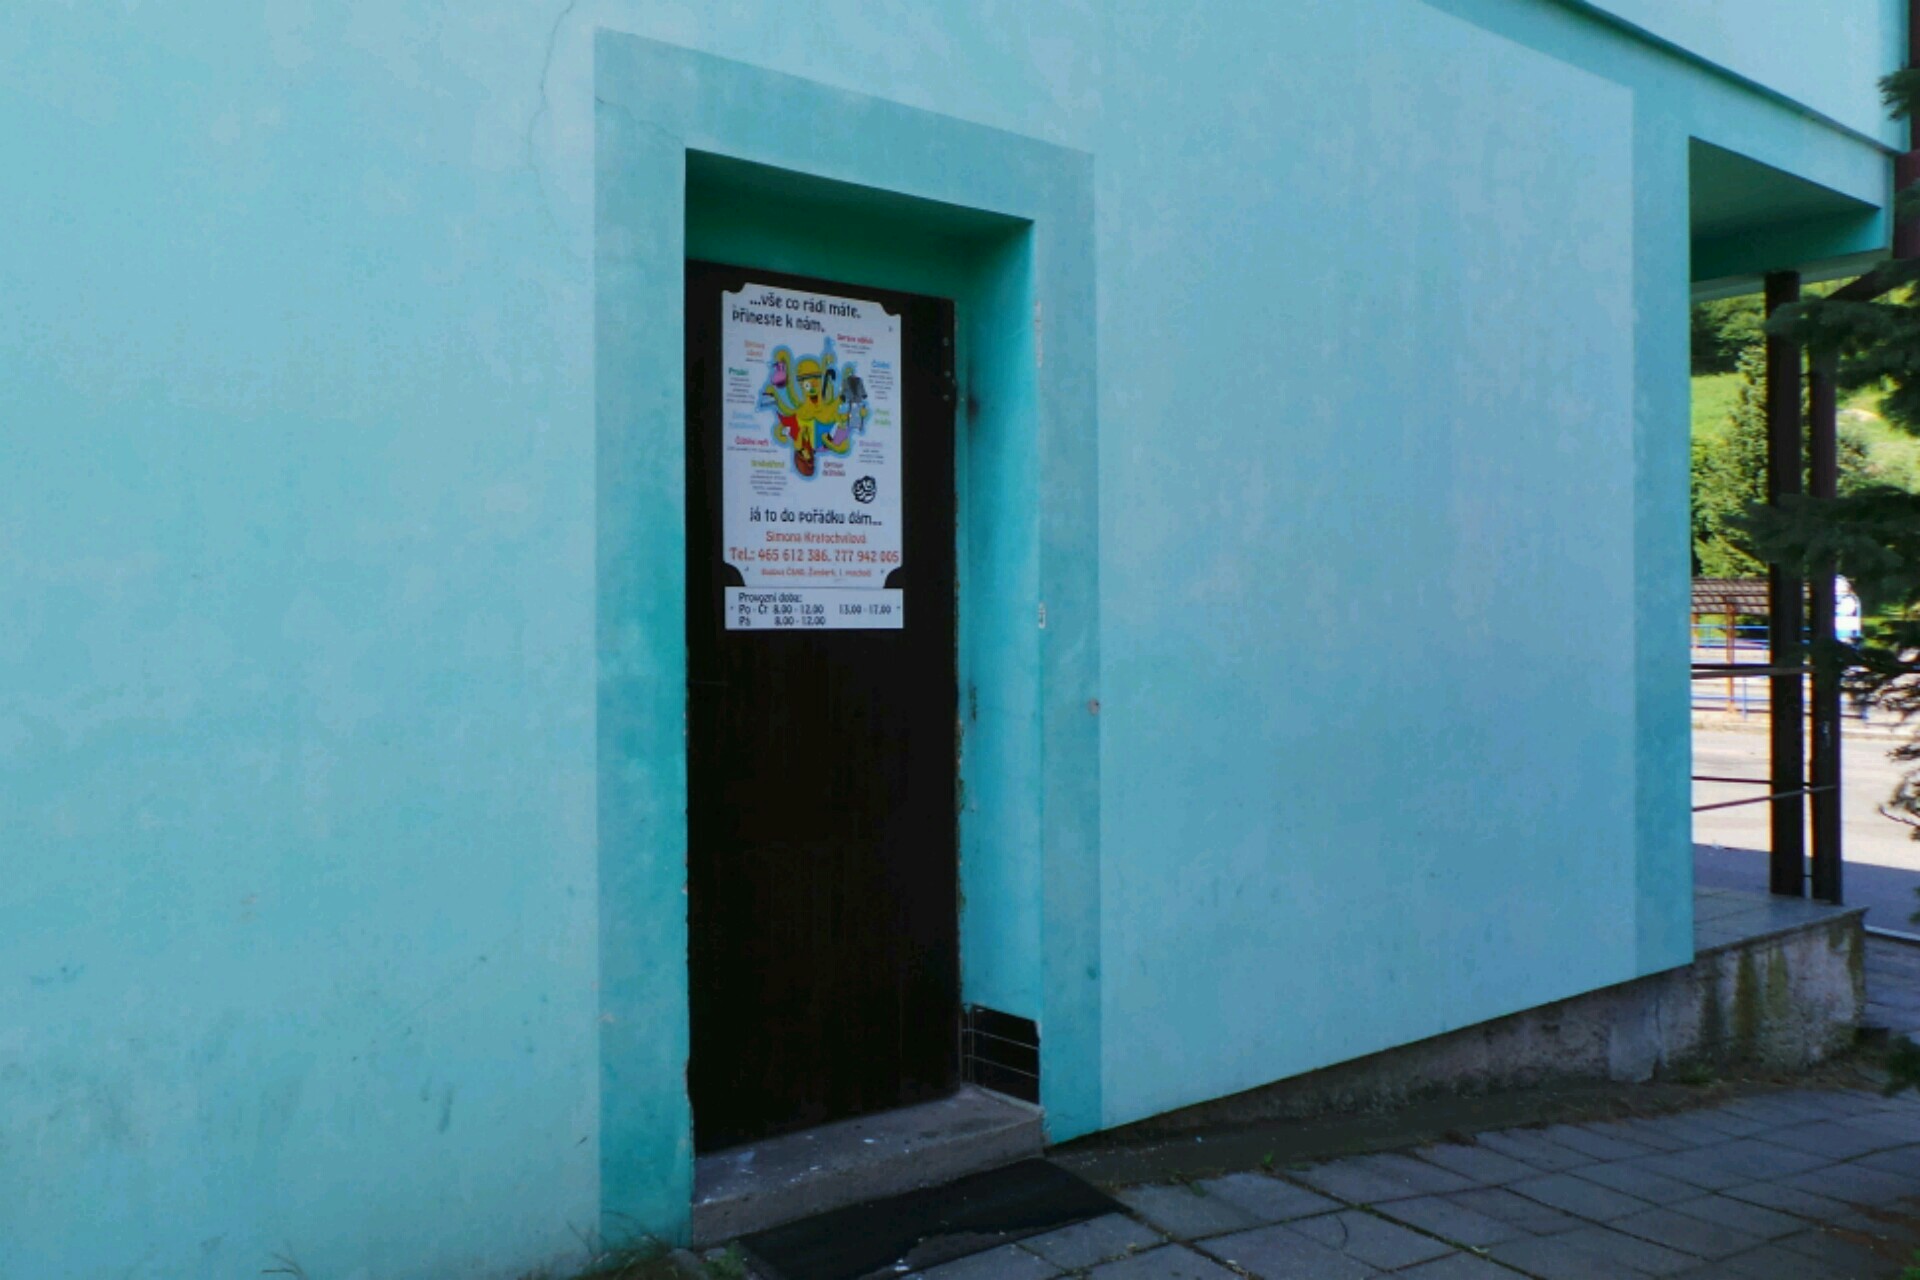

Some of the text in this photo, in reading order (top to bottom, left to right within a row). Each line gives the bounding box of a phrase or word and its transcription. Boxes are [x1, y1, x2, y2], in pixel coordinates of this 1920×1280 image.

[750, 292, 782, 307] ...vše
[786, 298, 799, 311] co
[803, 299, 826, 314] rádi
[732, 306, 782, 326] přineste
[786, 315, 793, 328] k
[765, 509, 777, 522] to
[780, 510, 795, 522] do
[800, 509, 845, 525] pořádku
[766, 531, 801, 543] Simona
[729, 547, 754, 561] Tel.:
[758, 549, 779, 561] 465
[783, 549, 803, 561] 612
[835, 549, 853, 562] 777
[858, 550, 876, 563] 942
[880, 550, 899, 564] 005
[738, 592, 776, 604] Provozní
[738, 605, 750, 615] Po
[773, 604, 792, 615] 8.00
[801, 604, 824, 615] 12.00
[839, 604, 862, 615] 13.00
[869, 604, 892, 615] 17.00
[774, 616, 794, 626] 8.00
[801, 616, 826, 626] 12.00
